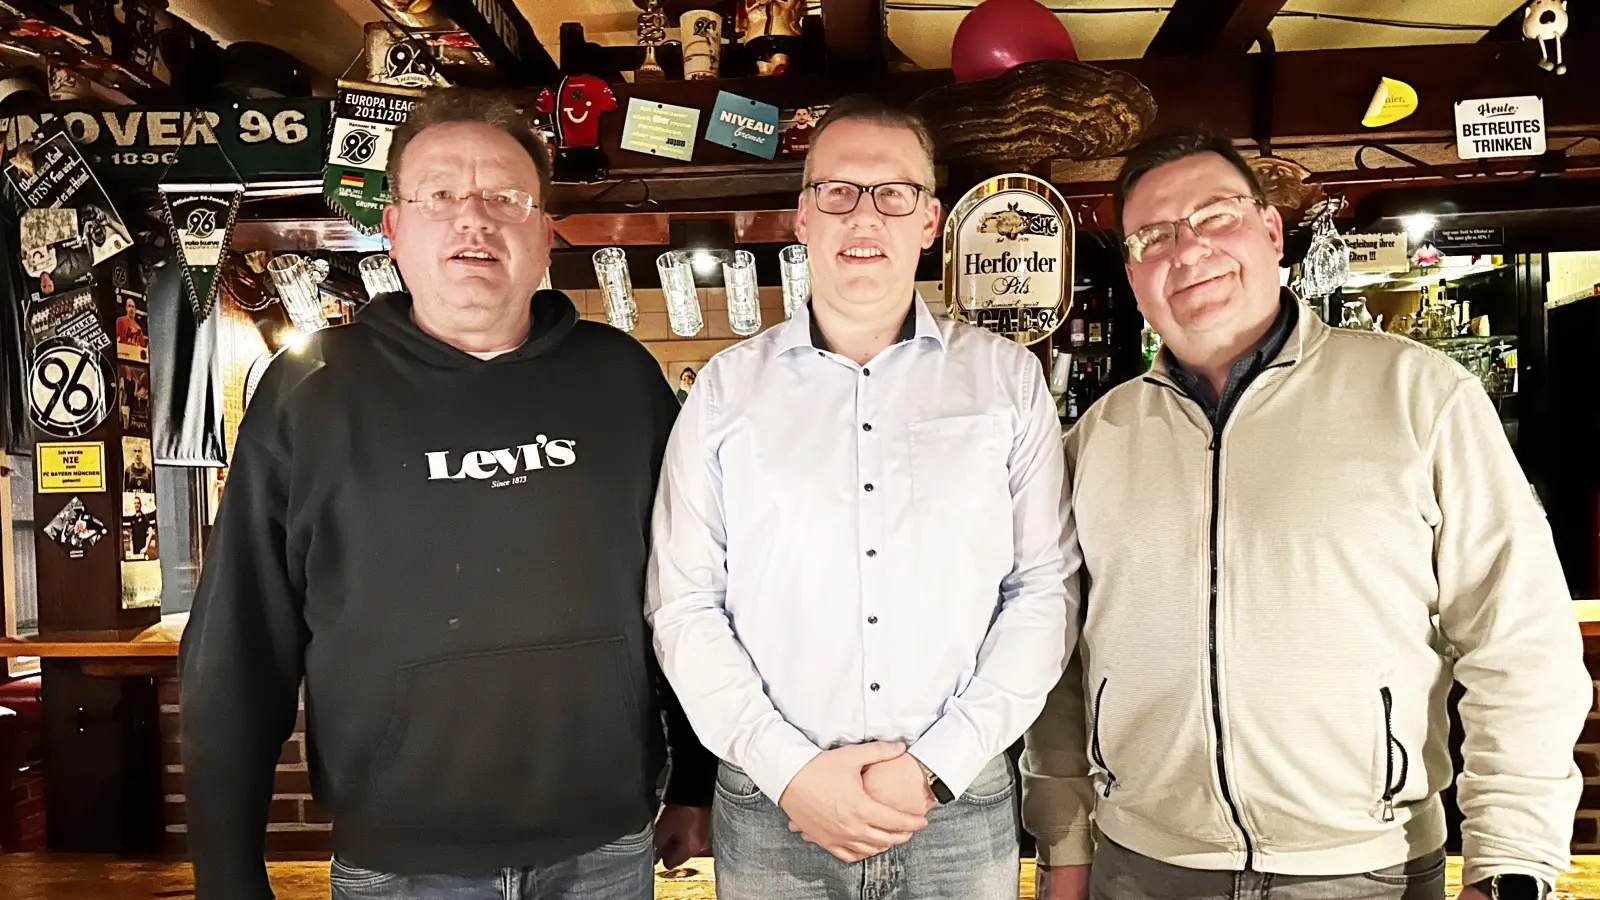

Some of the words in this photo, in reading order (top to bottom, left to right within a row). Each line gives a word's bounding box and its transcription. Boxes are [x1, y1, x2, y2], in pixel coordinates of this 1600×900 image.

[345, 93, 386, 109] EUROPA
[389, 99, 415, 112] LEAG
[354, 106, 408, 123] 2011/201
[720, 110, 775, 135] NIVEAU
[239, 110, 308, 144] 96
[1462, 119, 1541, 137] BETREUTES
[338, 130, 379, 164] 96
[1472, 136, 1532, 153] TRINKEN
[28, 177, 52, 206] BTSV
[355, 200, 378, 210] GRUPPE
[187, 209, 216, 237] 96
[964, 251, 1057, 275] Herforder
[992, 276, 1030, 295] Pils
[38, 350, 94, 420] 96
[63, 456, 79, 464] NIE
[424, 434, 576, 480] Levi's
[491, 480, 510, 488] Since
[512, 476, 527, 485] 1873
